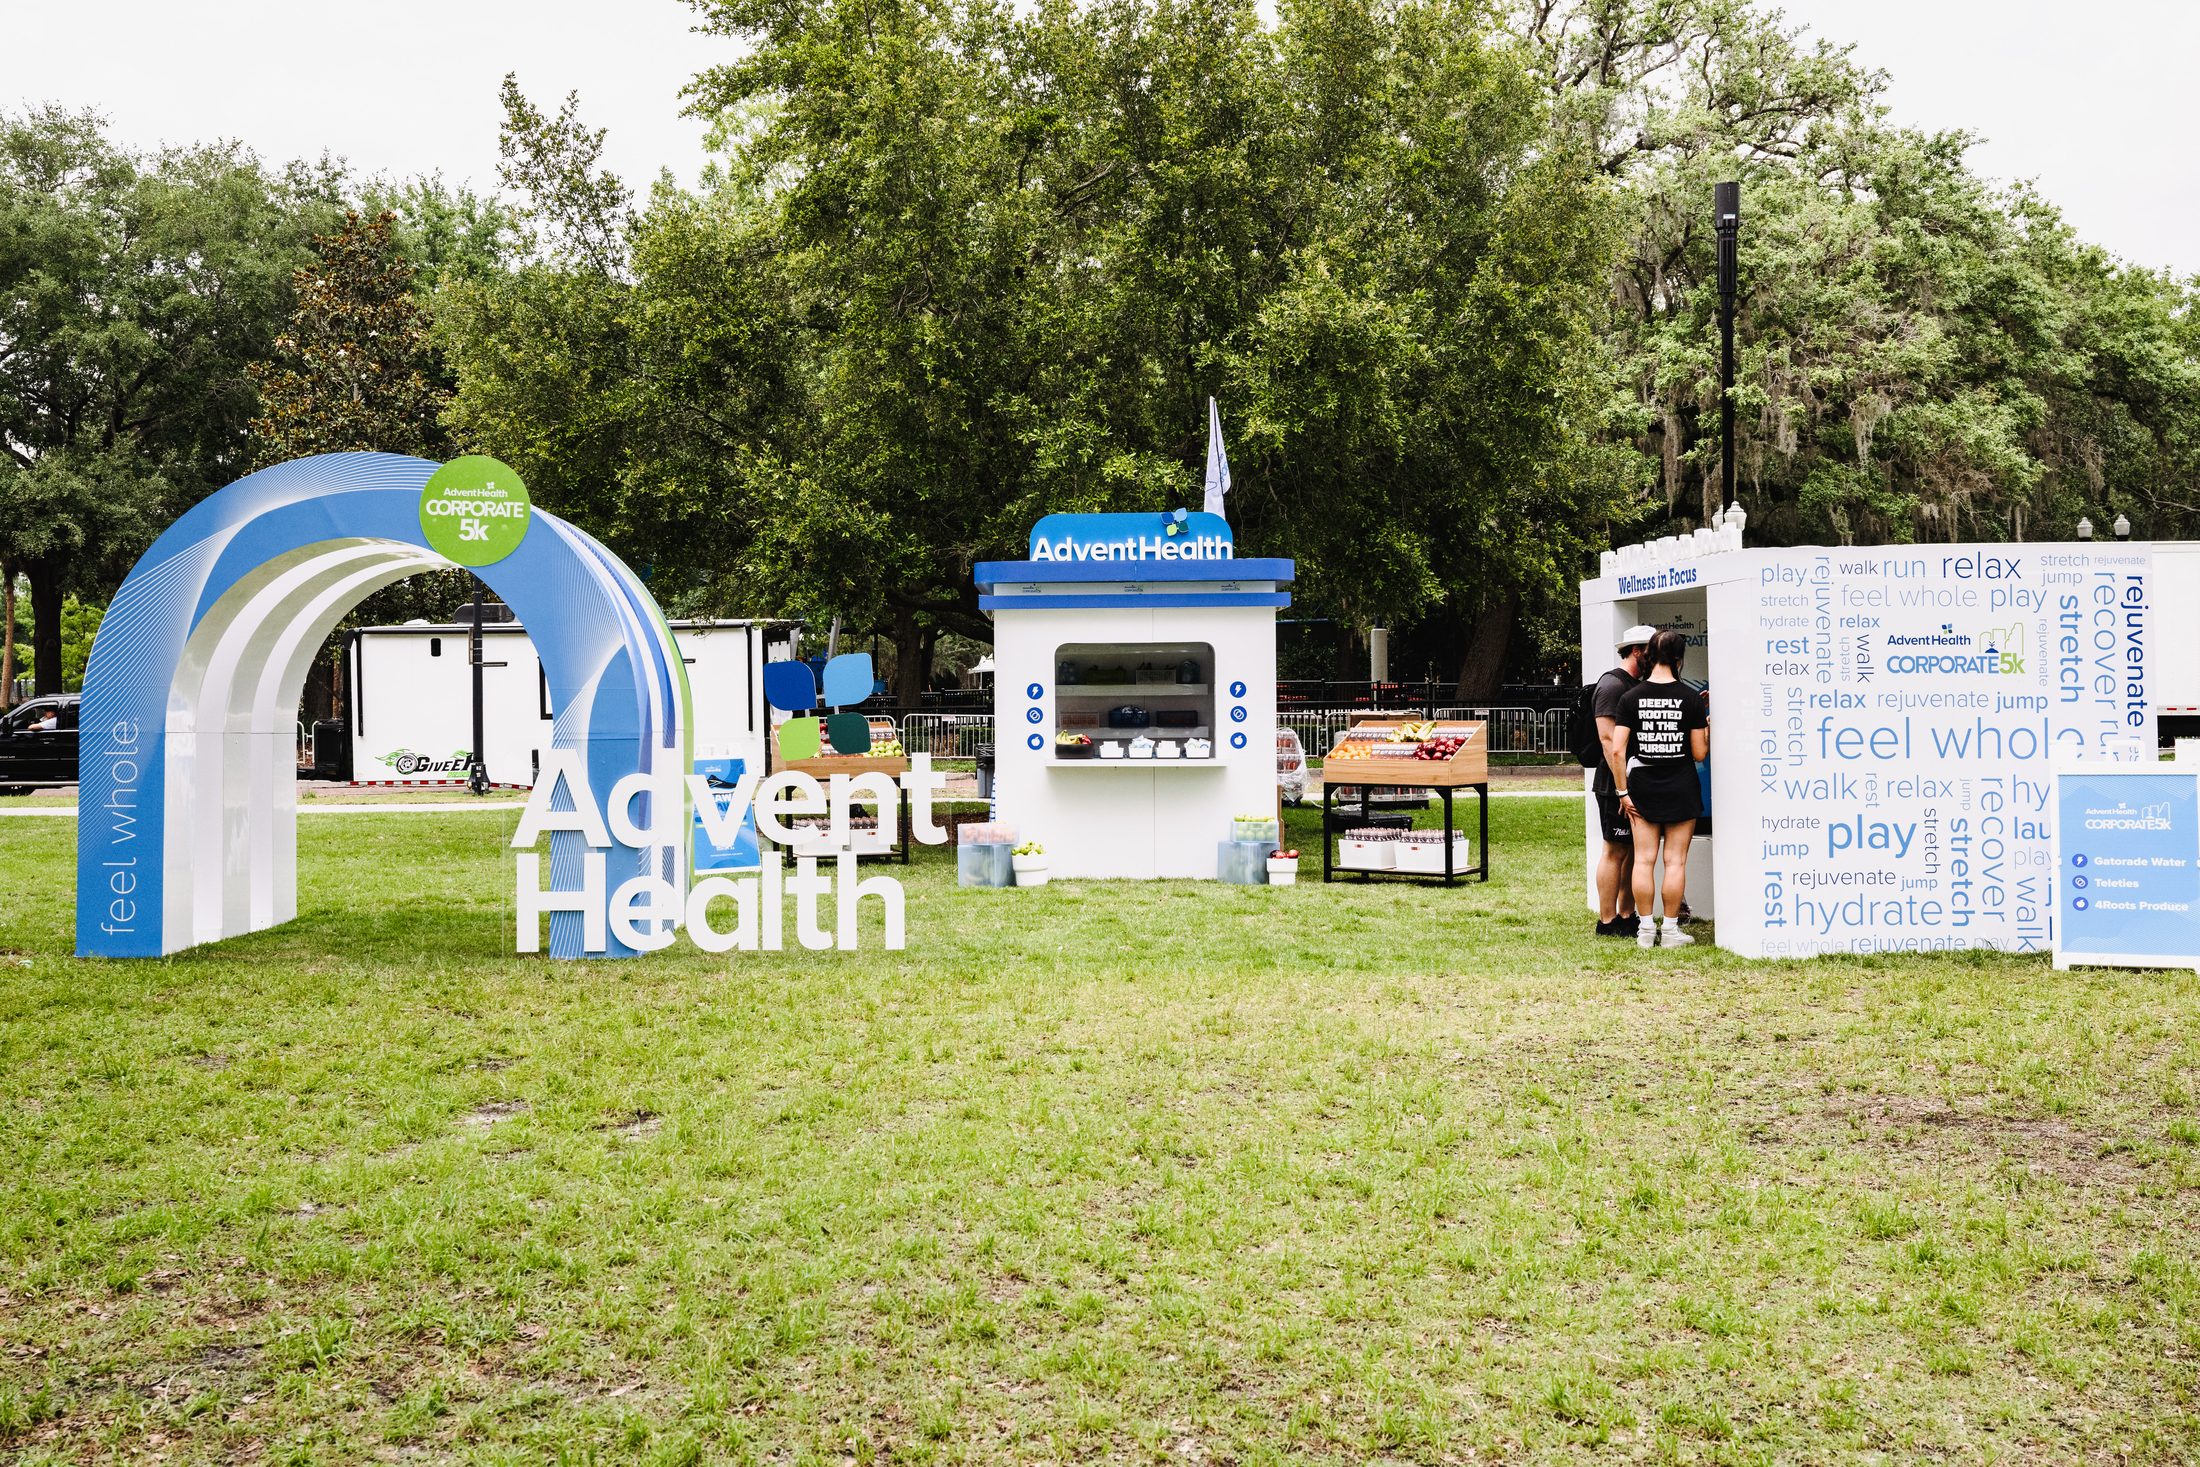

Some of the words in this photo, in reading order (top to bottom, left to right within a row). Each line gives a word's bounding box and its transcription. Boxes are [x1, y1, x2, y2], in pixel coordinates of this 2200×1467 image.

[443, 487, 508, 498] AdventHealth
[426, 499, 524, 518] CORPORATE
[458, 518, 489, 541] 5k
[1031, 536, 1233, 562] AdventHealth
[2040, 553, 2089, 567] stretch
[1839, 560, 1878, 575] walk
[1883, 560, 1926, 577] run
[1942, 552, 2021, 579] relax
[2094, 556, 2146, 566] rejuvenate
[1618, 575, 1656, 594] Wellness
[1658, 571, 1667, 587] in
[1669, 567, 1697, 587] Focus
[1761, 563, 1807, 587] play
[2042, 570, 2082, 587] jump
[1761, 594, 1808, 607] stretch
[1841, 584, 1891, 607] feel
[1991, 583, 2047, 614] play
[1760, 616, 1809, 629] hydrate
[1811, 556, 1834, 683] rejuvenate
[1839, 614, 1880, 628] relax
[1767, 637, 1809, 654] rest
[1887, 635, 1971, 646] AdventHealth
[2060, 594, 2086, 703] stretch
[2093, 573, 2116, 710] recover
[2121, 576, 2149, 727] rejuvenate
[1840, 636, 1850, 681] stretch
[1857, 634, 1874, 683] walk
[2037, 618, 2050, 687] rejuvenate
[1765, 660, 1809, 676] relax
[1638, 698, 1683, 708] DEEPLY
[1760, 683, 1774, 717] jump
[1810, 689, 1866, 708] relax
[1877, 690, 1989, 712] rejuvenate
[1995, 691, 2048, 714] jump
[1638, 710, 1682, 720] ROOTED
[1642, 721, 1654, 730] IN
[1656, 721, 1678, 730] THE
[1788, 687, 1807, 766] stretch
[1637, 732, 1684, 741] CREATIVE
[1639, 743, 1683, 753] PURSUIT
[1816, 717, 1910, 760] feel
[1761, 730, 1782, 793] relax
[510, 748, 949, 848] Advent
[1784, 773, 1857, 800] walk
[1866, 773, 1880, 808] rest
[1886, 775, 1953, 799] relax
[1960, 779, 1972, 811] jump
[1762, 816, 1820, 833] hydrate
[1828, 814, 1917, 859] play
[1924, 808, 1941, 874] stretch
[1762, 841, 1809, 860] jump
[1981, 778, 2005, 922] recover
[1951, 818, 1975, 927] stretch
[2094, 857, 2148, 866] Gatorade
[2151, 858, 2187, 867] Water
[1792, 869, 1896, 890] rejuvenate
[1900, 876, 1938, 891] jump
[2094, 878, 2139, 888] Teleties
[101, 857, 136, 935] feel
[516, 852, 906, 952] Health
[1765, 871, 1787, 928] rest
[2095, 900, 2137, 910] 4Roots
[2139, 902, 2189, 911] Produce
[1795, 893, 1942, 935] hydrate
[2016, 877, 2043, 951] walk
[1761, 938, 1791, 953] feel
[1796, 938, 1844, 953] whole
[1851, 935, 1966, 952] rejuvenate
[1974, 935, 2010, 951] pay
